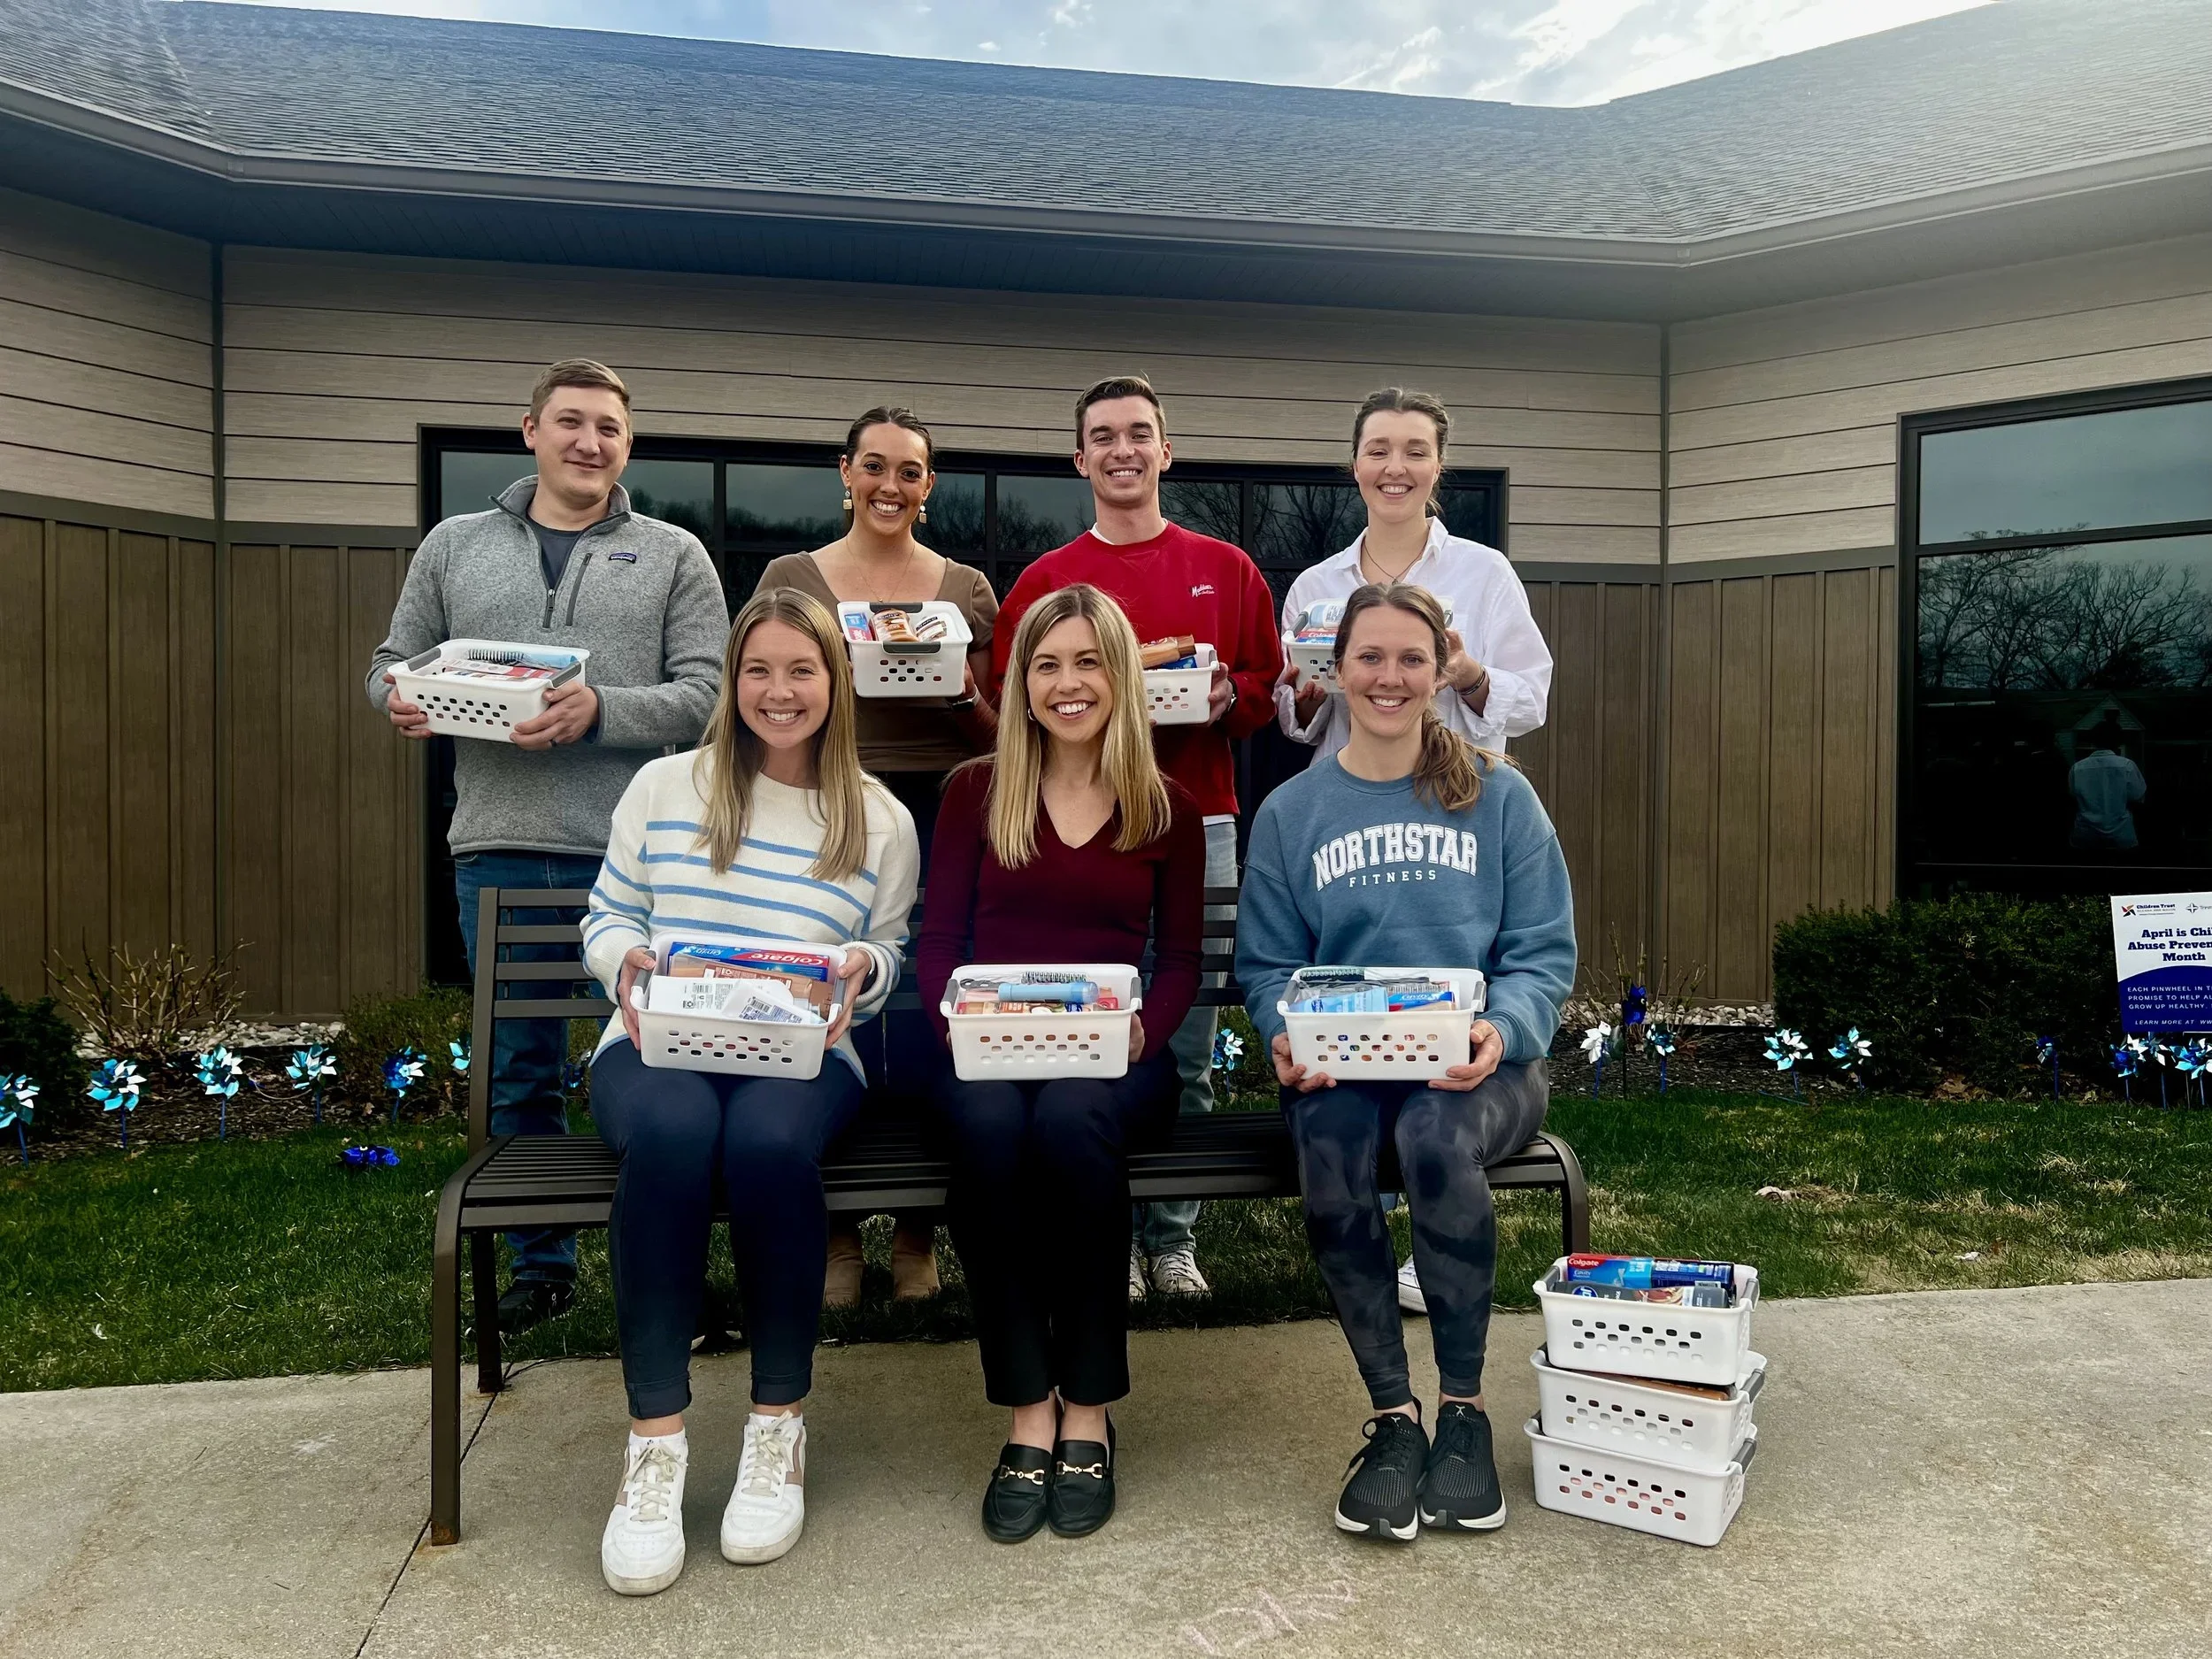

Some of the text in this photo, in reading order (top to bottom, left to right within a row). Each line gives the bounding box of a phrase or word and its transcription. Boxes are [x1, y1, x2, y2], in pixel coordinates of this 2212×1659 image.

[1312, 823, 1478, 892] NORTHSTAR
[1349, 870, 1436, 887] FITNESS
[2141, 928, 2173, 940] April
[2190, 927, 2212, 936] Chi
[2128, 941, 2166, 950] Abuse
[751, 953, 824, 966] Colgate
[2162, 952, 2206, 961] Month
[1569, 1258, 1599, 1267] Colgate
